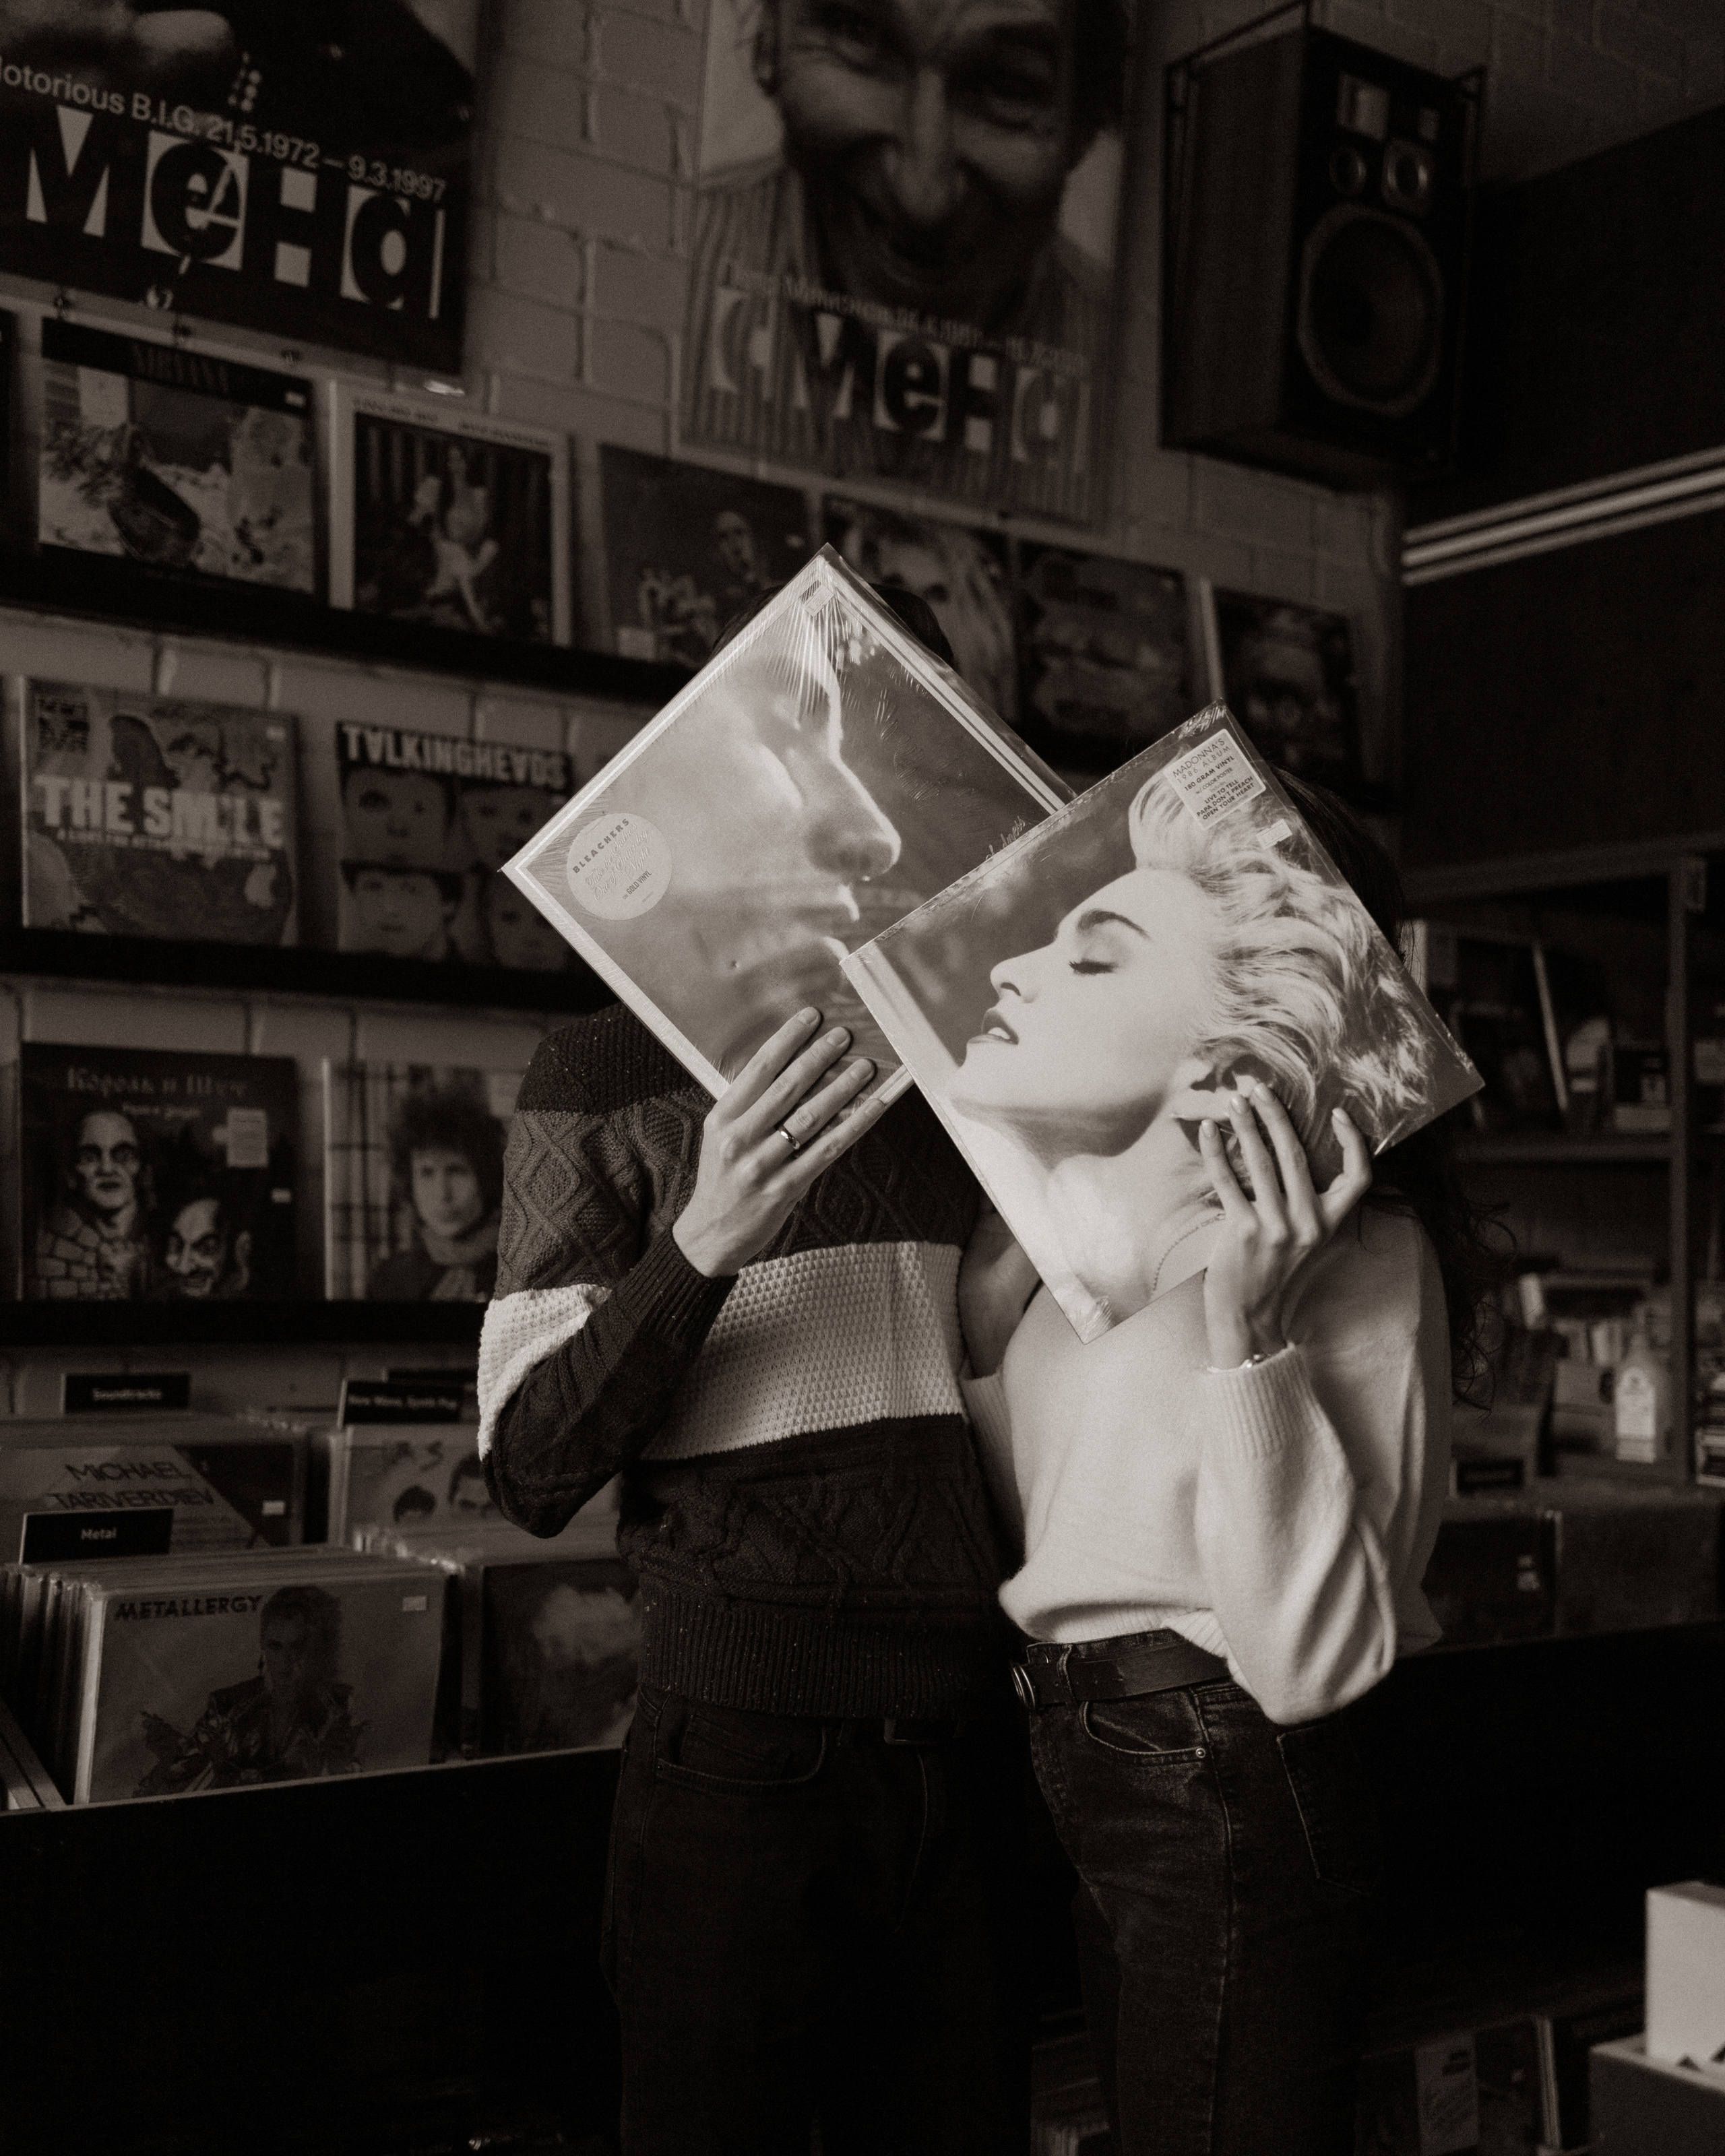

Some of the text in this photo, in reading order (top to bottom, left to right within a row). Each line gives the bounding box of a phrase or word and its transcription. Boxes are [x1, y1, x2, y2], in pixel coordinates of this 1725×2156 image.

[348, 154, 446, 202] 9.3.1997
[1172, 738, 1225, 778] MADONNA'S
[1177, 745, 1230, 784] 1986 ALBUM
[1185, 755, 1235, 791] 180 GRAM VINYL
[1197, 804, 1212, 817] PAPA
[1212, 791, 1231, 806] DON'T
[1231, 776, 1253, 793] PREACH
[1202, 778, 1218, 790] COLOR
[1217, 767, 1233, 780] POSTER
[1204, 779, 1238, 804] LIVE TO TELL
[33, 775, 135, 833] THE
[1202, 806, 1218, 820] OPEN
[1219, 795, 1236, 808] YOUR
[1236, 782, 1255, 797] HEART
[572, 818, 630, 873] BLEACHERS
[626, 881, 639, 895] GOLD
[637, 869, 652, 884] VINYL
[65, 1461, 193, 1481] MICHAEL
[80, 1527, 118, 1541] Metal
[115, 1595, 263, 1620] METALLERGY
